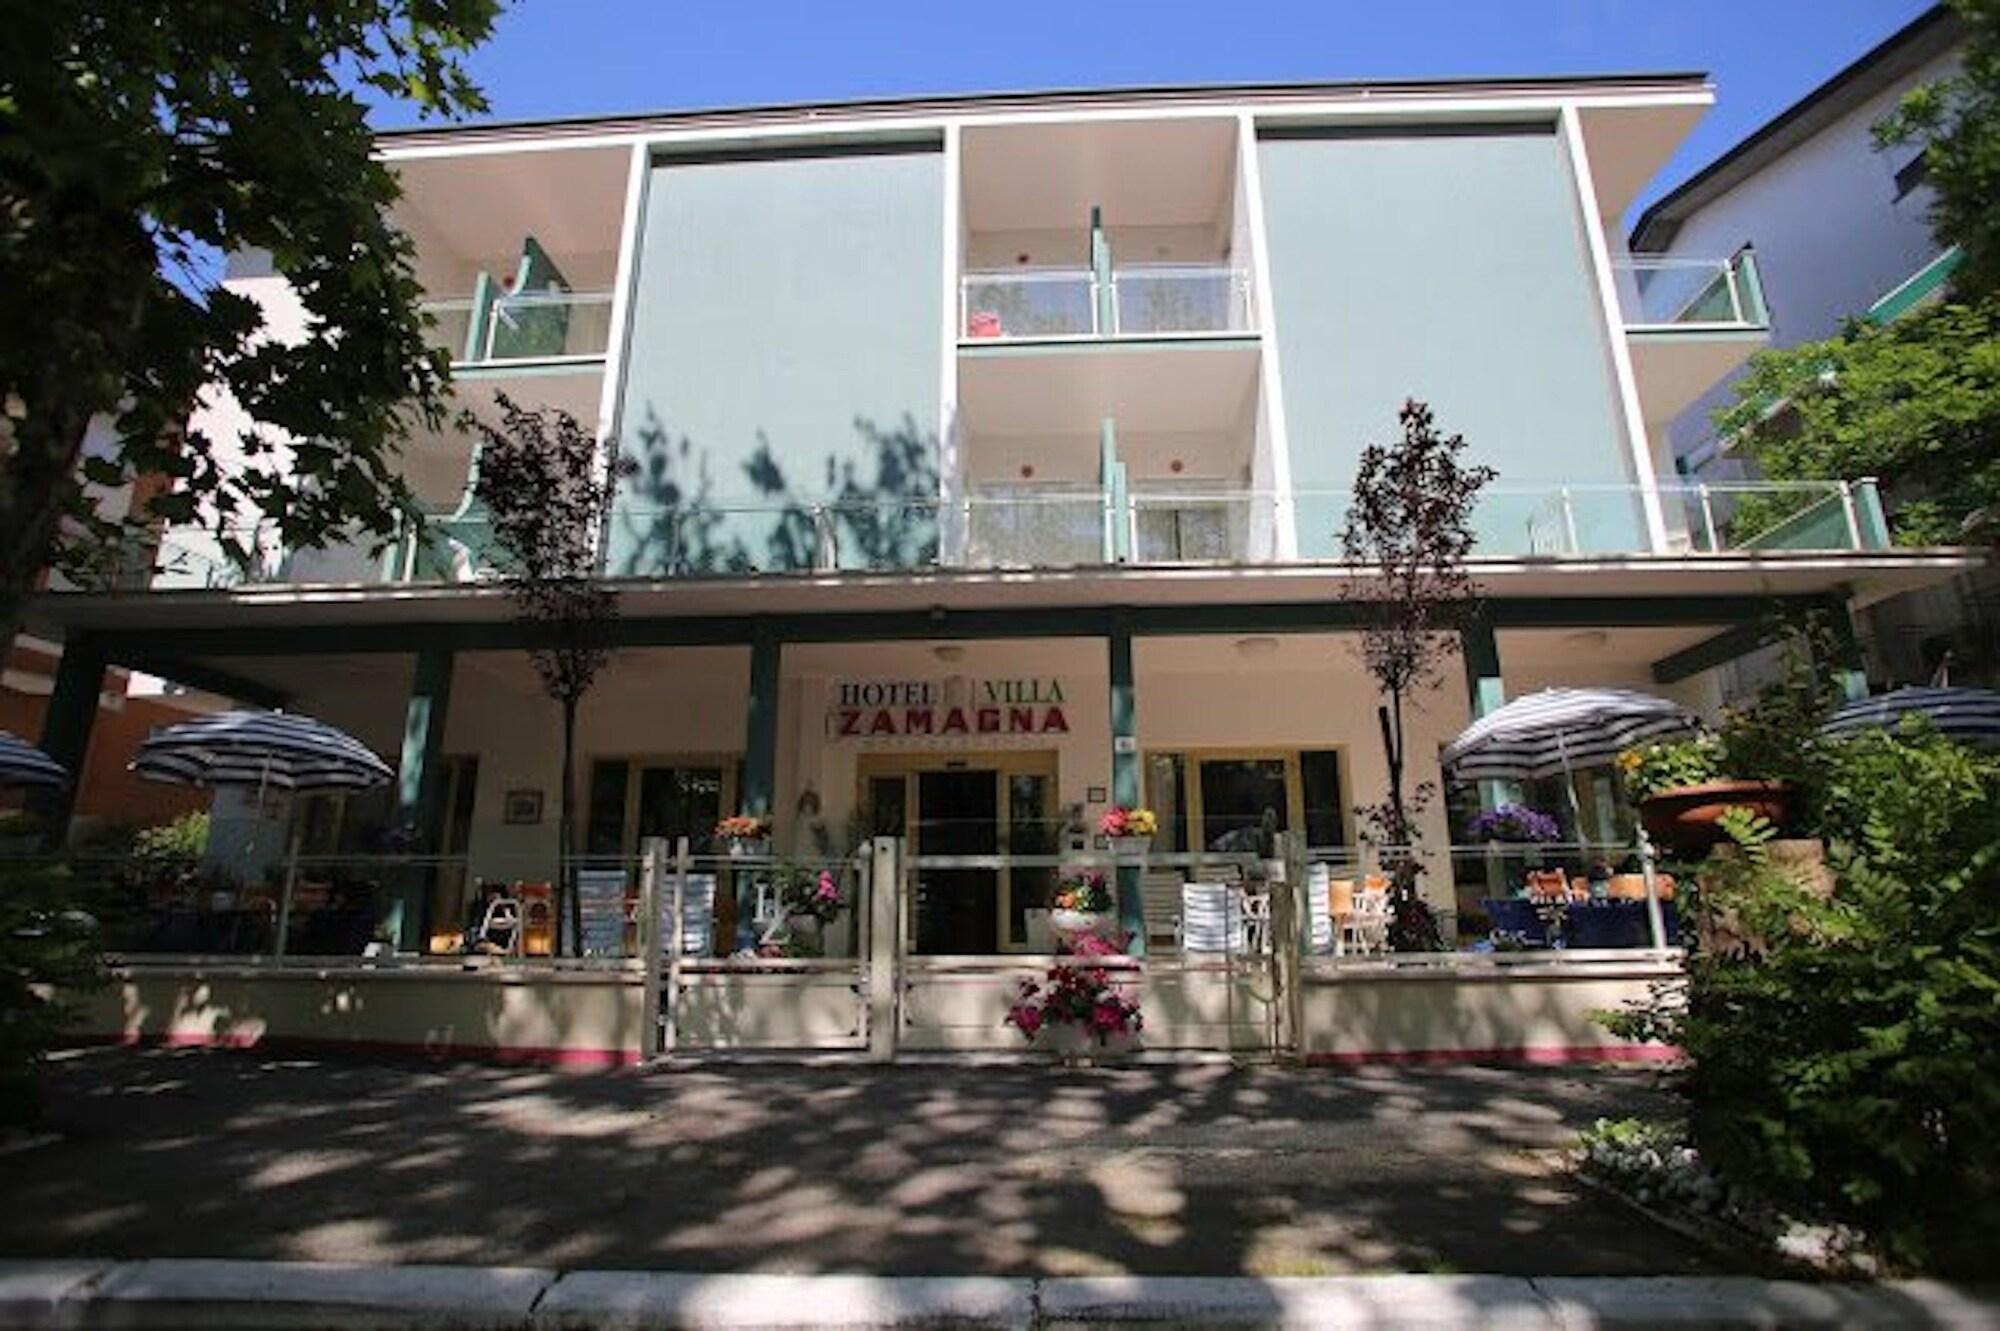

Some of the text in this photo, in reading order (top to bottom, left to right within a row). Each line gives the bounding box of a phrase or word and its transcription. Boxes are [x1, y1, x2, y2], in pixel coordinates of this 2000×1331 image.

[840, 678, 1064, 706] HOTEL VILLA
[839, 706, 1070, 735] ZAMAGNA
